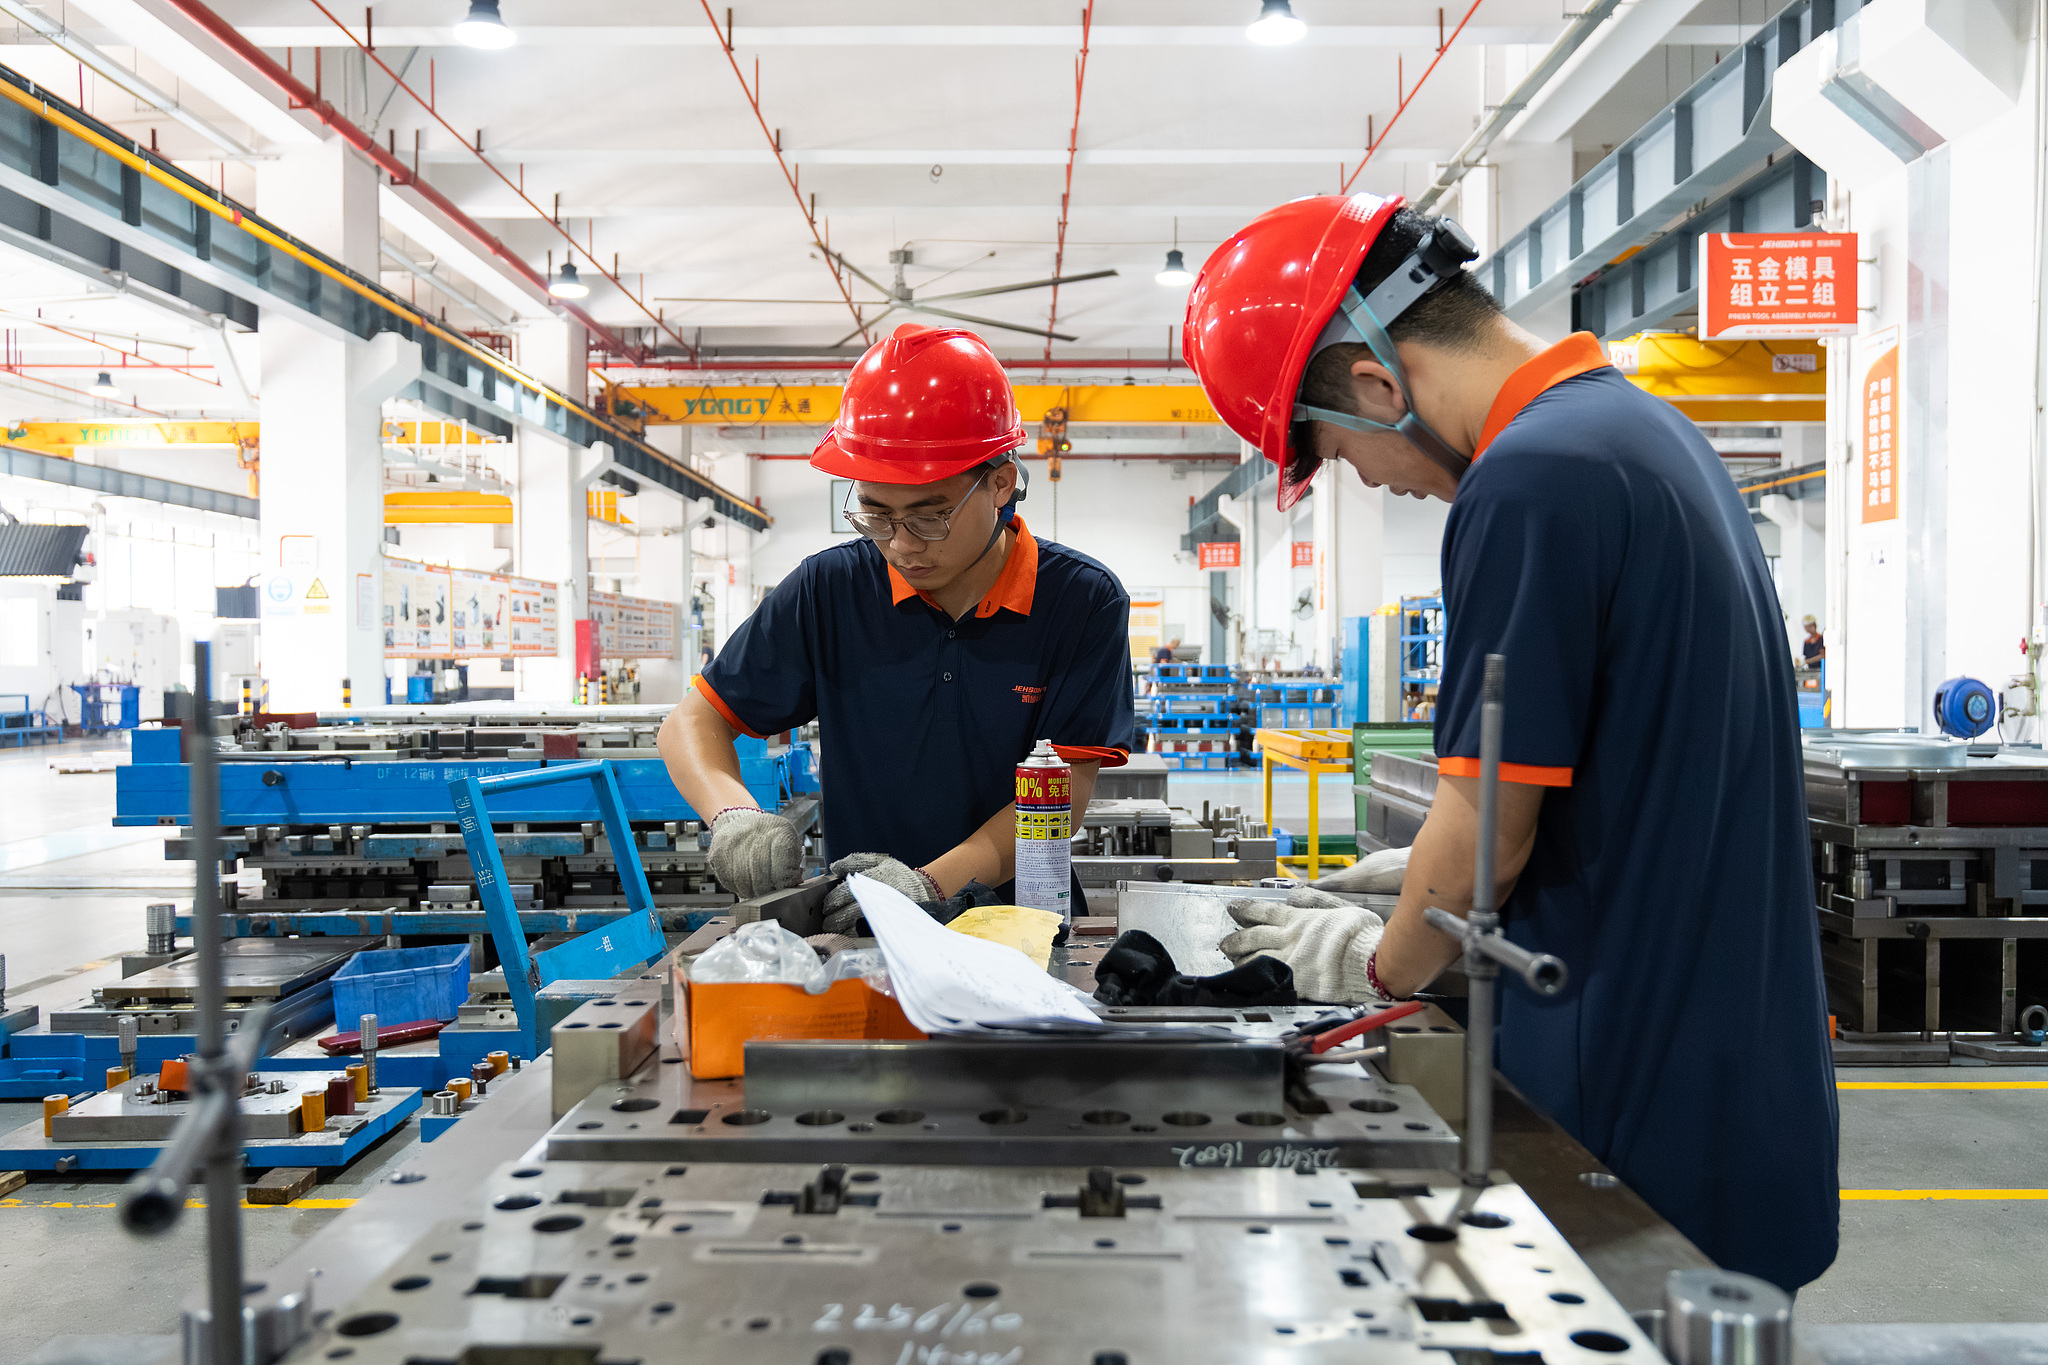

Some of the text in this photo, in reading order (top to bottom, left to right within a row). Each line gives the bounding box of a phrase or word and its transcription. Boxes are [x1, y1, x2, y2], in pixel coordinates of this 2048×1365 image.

[1730, 256, 1835, 281] 五金模具
[1730, 282, 1836, 307] 组立二组
[1016, 776, 1043, 798] 30%
[1048, 784, 1070, 798] 免费
